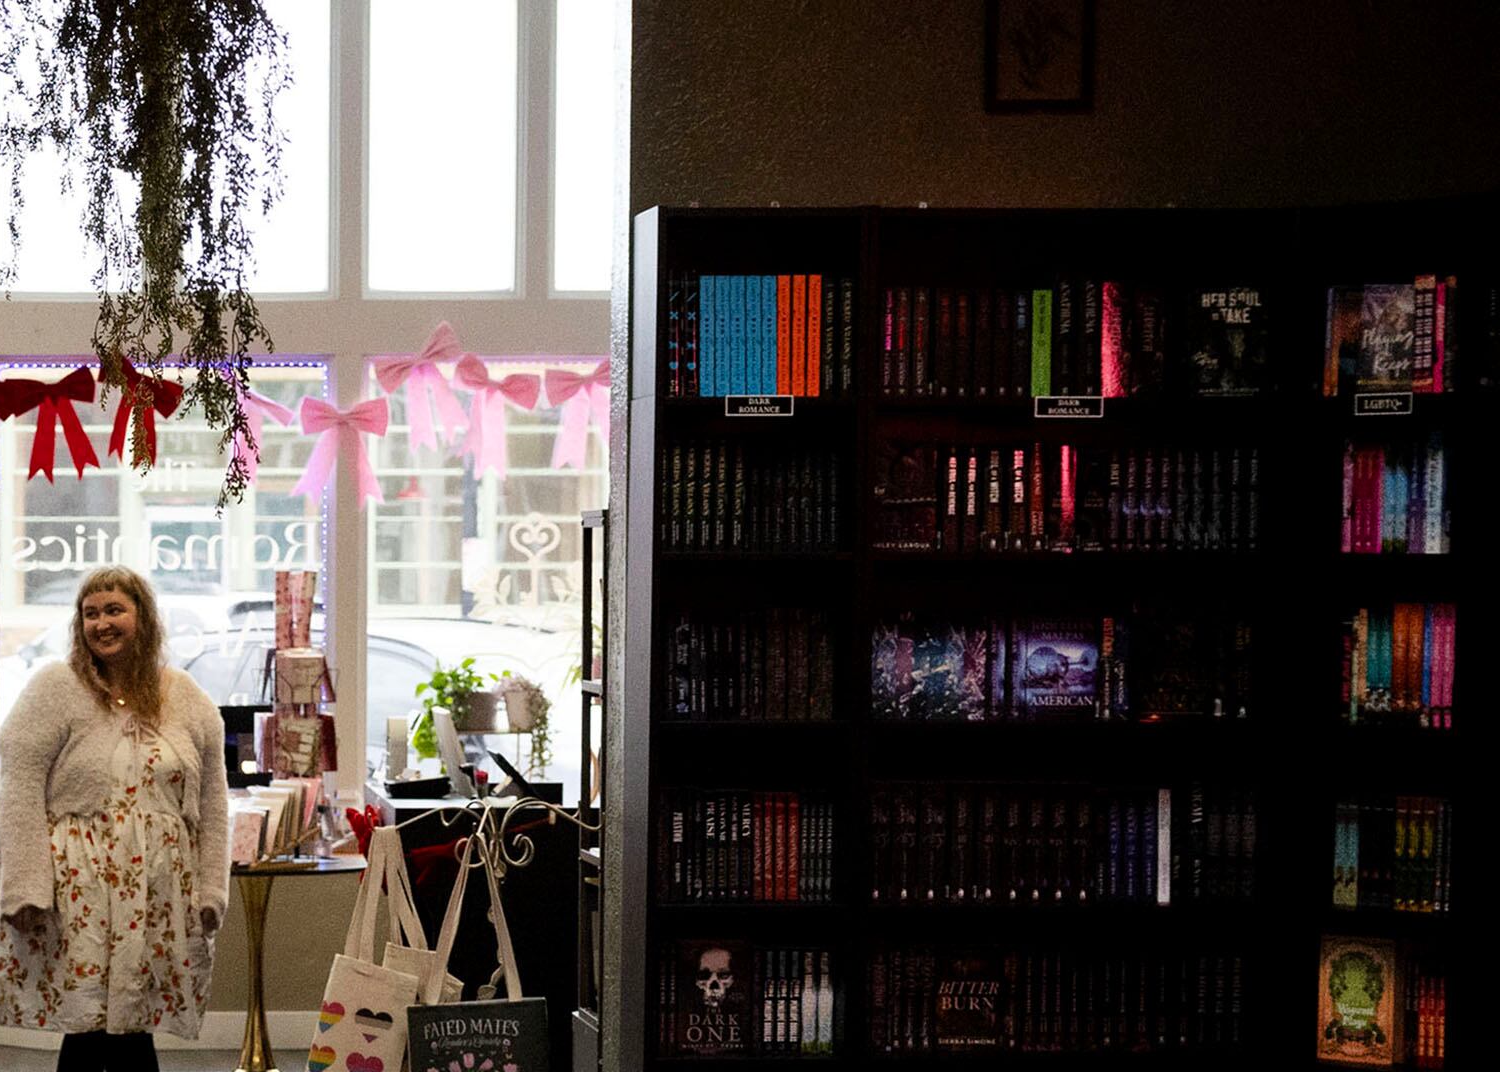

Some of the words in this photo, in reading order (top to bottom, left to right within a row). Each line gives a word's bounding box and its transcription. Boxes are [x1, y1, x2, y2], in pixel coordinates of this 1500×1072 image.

[1201, 292, 1226, 307] HER
[1228, 292, 1262, 307] SOUL
[1220, 308, 1251, 324] TAKE
[1029, 695, 1094, 707] AMERICAN
[706, 801, 715, 840] PRAISE
[741, 802, 751, 838] MERCY
[938, 981, 1000, 995] BITTER
[941, 996, 995, 1010] BURN
[688, 1013, 739, 1025] DARK
[424, 1018, 467, 1040] FATED
[470, 1018, 520, 1037] MATES
[686, 1027, 741, 1042] ONE
